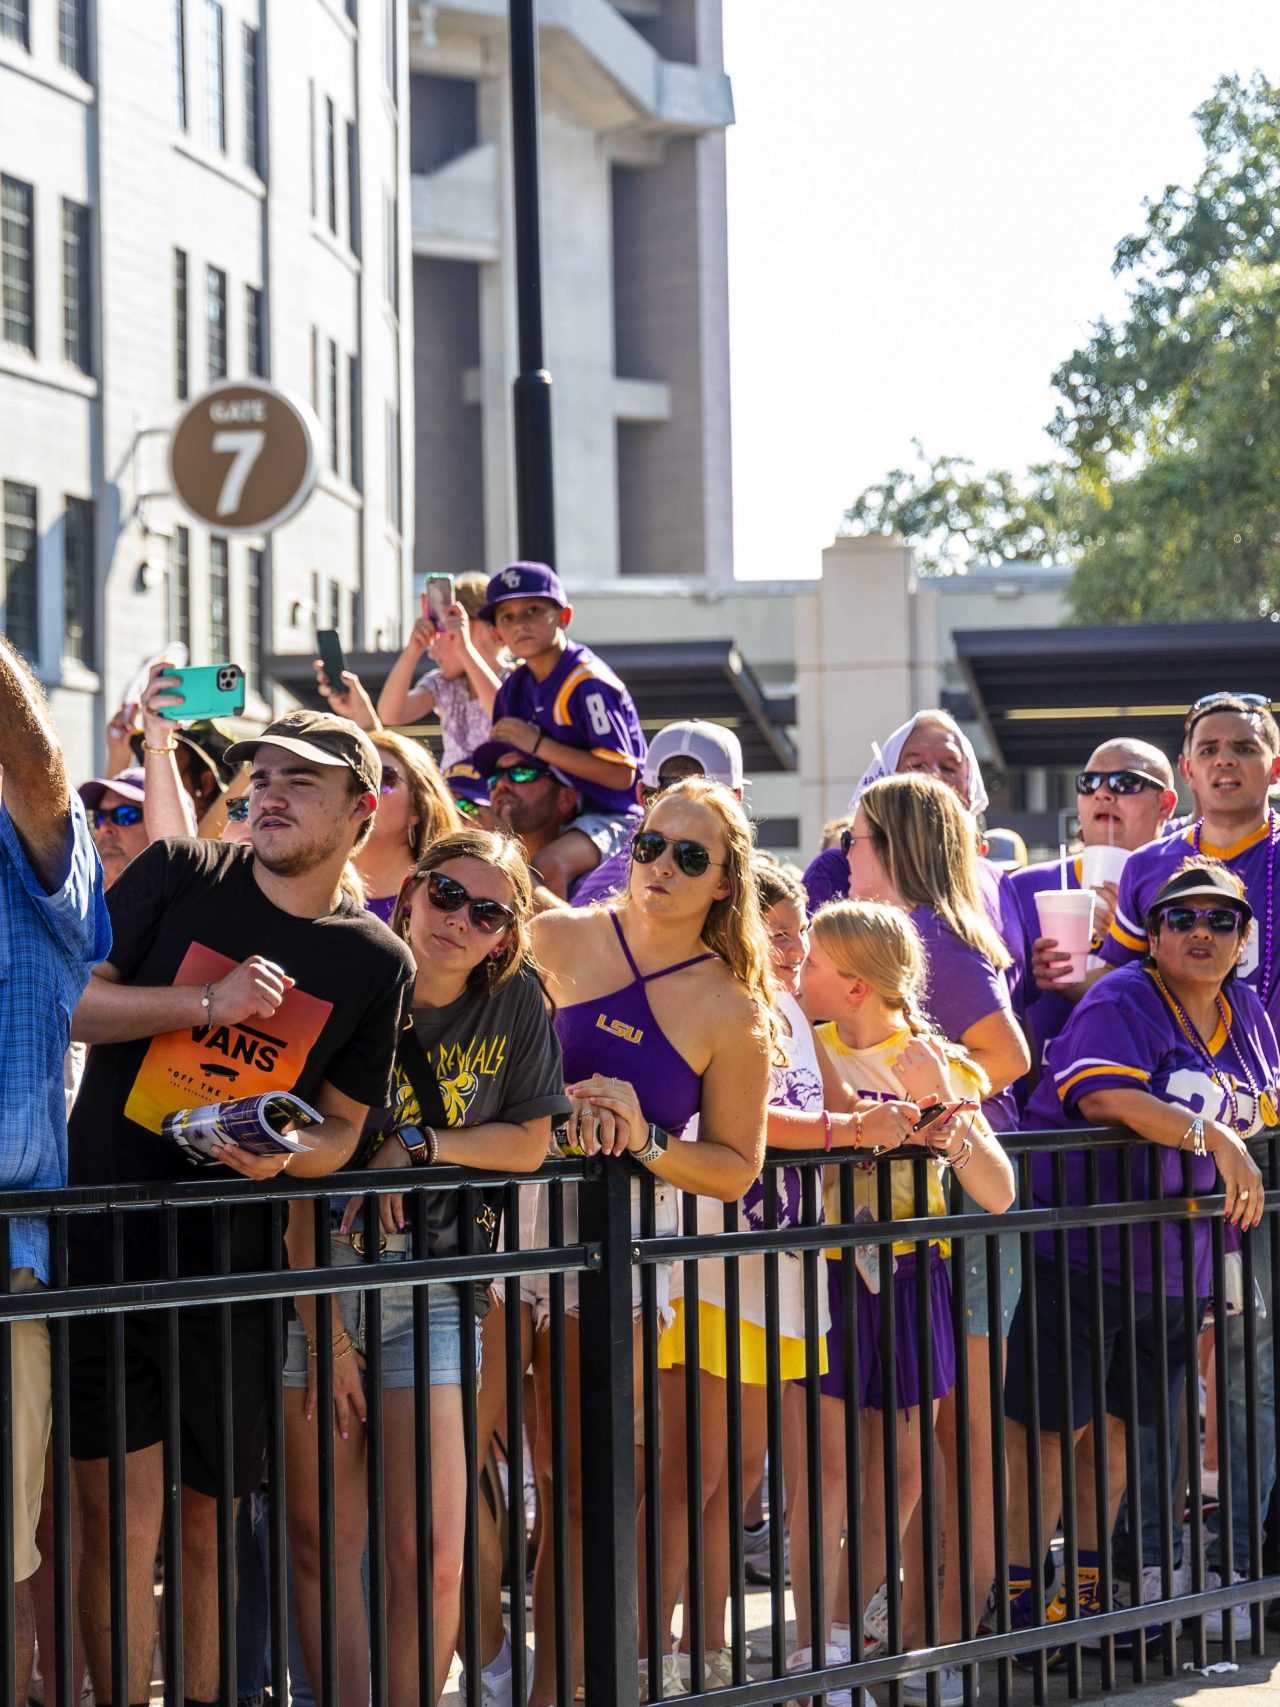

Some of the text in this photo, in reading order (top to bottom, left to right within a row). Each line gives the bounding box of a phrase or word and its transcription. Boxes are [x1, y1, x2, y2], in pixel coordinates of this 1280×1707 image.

[209, 400, 267, 424] GATE
[212, 429, 267, 517] 7
[586, 693, 611, 736] 8
[191, 1024, 279, 1072] VANS
[596, 1013, 644, 1044] LSU
